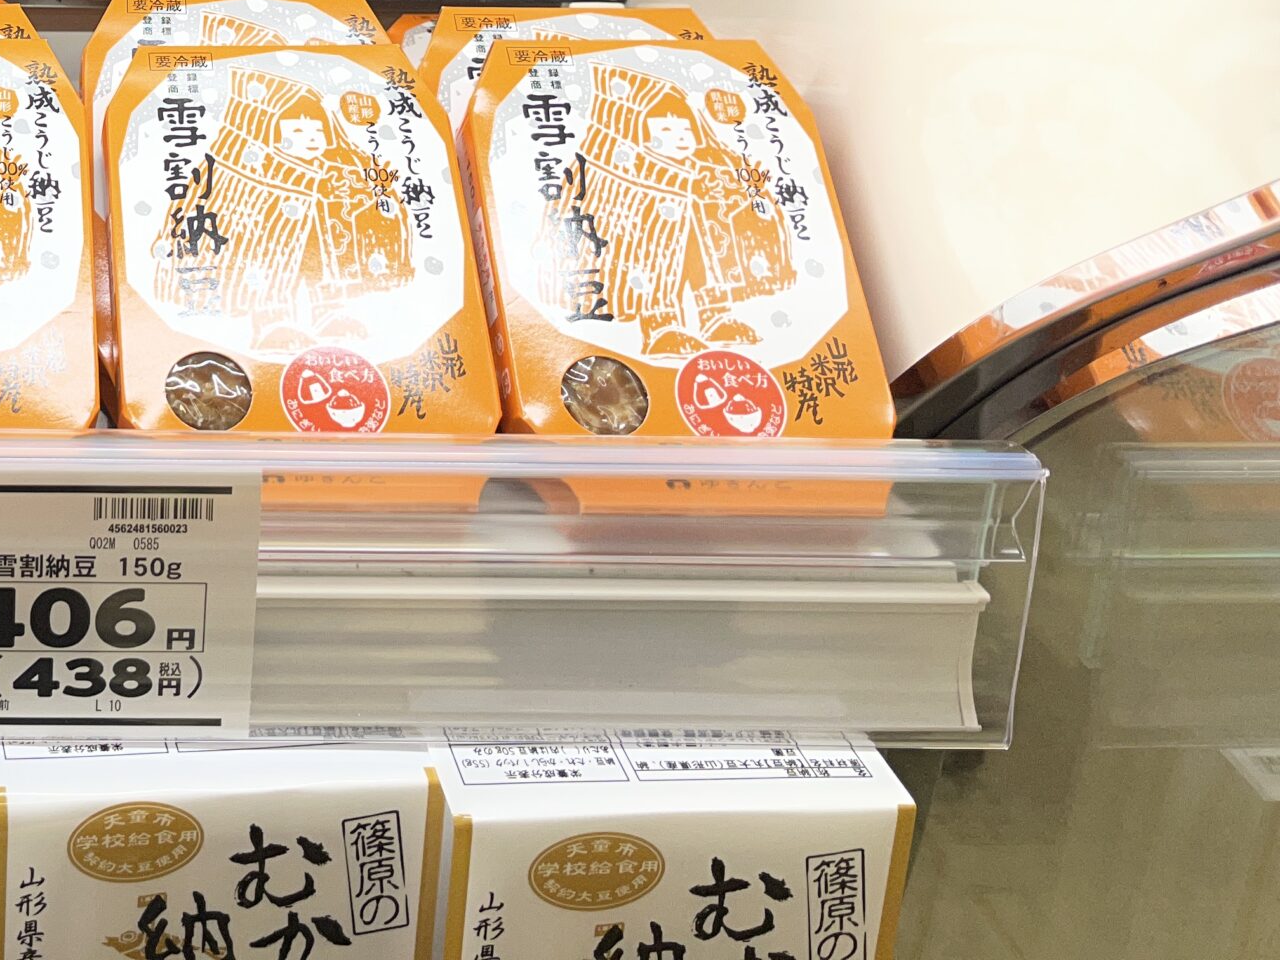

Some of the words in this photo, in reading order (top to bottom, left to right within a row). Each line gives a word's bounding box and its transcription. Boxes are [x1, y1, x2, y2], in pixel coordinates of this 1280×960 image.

[459, 15, 514, 31] 要冷蔵
[154, 54, 209, 70] 要冷蔵
[513, 49, 569, 65] 要冷蔵
[22, 60, 63, 234] 熟成こうじ納豆
[382, 64, 437, 240] 熟成こうじ納豆
[741, 60, 812, 242] 熟成こうじ納豆
[156, 97, 230, 317] 雪割納豆
[521, 93, 614, 323] 雪割納豆
[328, 367, 376, 384] 食べ方
[696, 357, 751, 372] おいしい
[722, 372, 769, 389] 食べ方
[107, 523, 189, 535] 4562481560023
[88, 536, 116, 551] Q02M
[132, 536, 160, 551] 0585
[119, 555, 182, 580] 150g
[165, 628, 196, 651] 円
[158, 661, 182, 677] 税込
[94, 699, 101, 712] L
[108, 699, 122, 713] 10
[503, 768, 582, 779] 栄養成分表示
[102, 808, 177, 831] 天童市
[74, 829, 199, 851] 学校給食用
[565, 839, 639, 858] 天童市
[82, 843, 189, 875] 契約大豆使用
[536, 859, 660, 878] 学校給食用
[349, 818, 401, 927] 篠原の
[542, 873, 649, 903] 契約大豆使用
[689, 856, 798, 960] む
[811, 855, 862, 960] 篠原の
